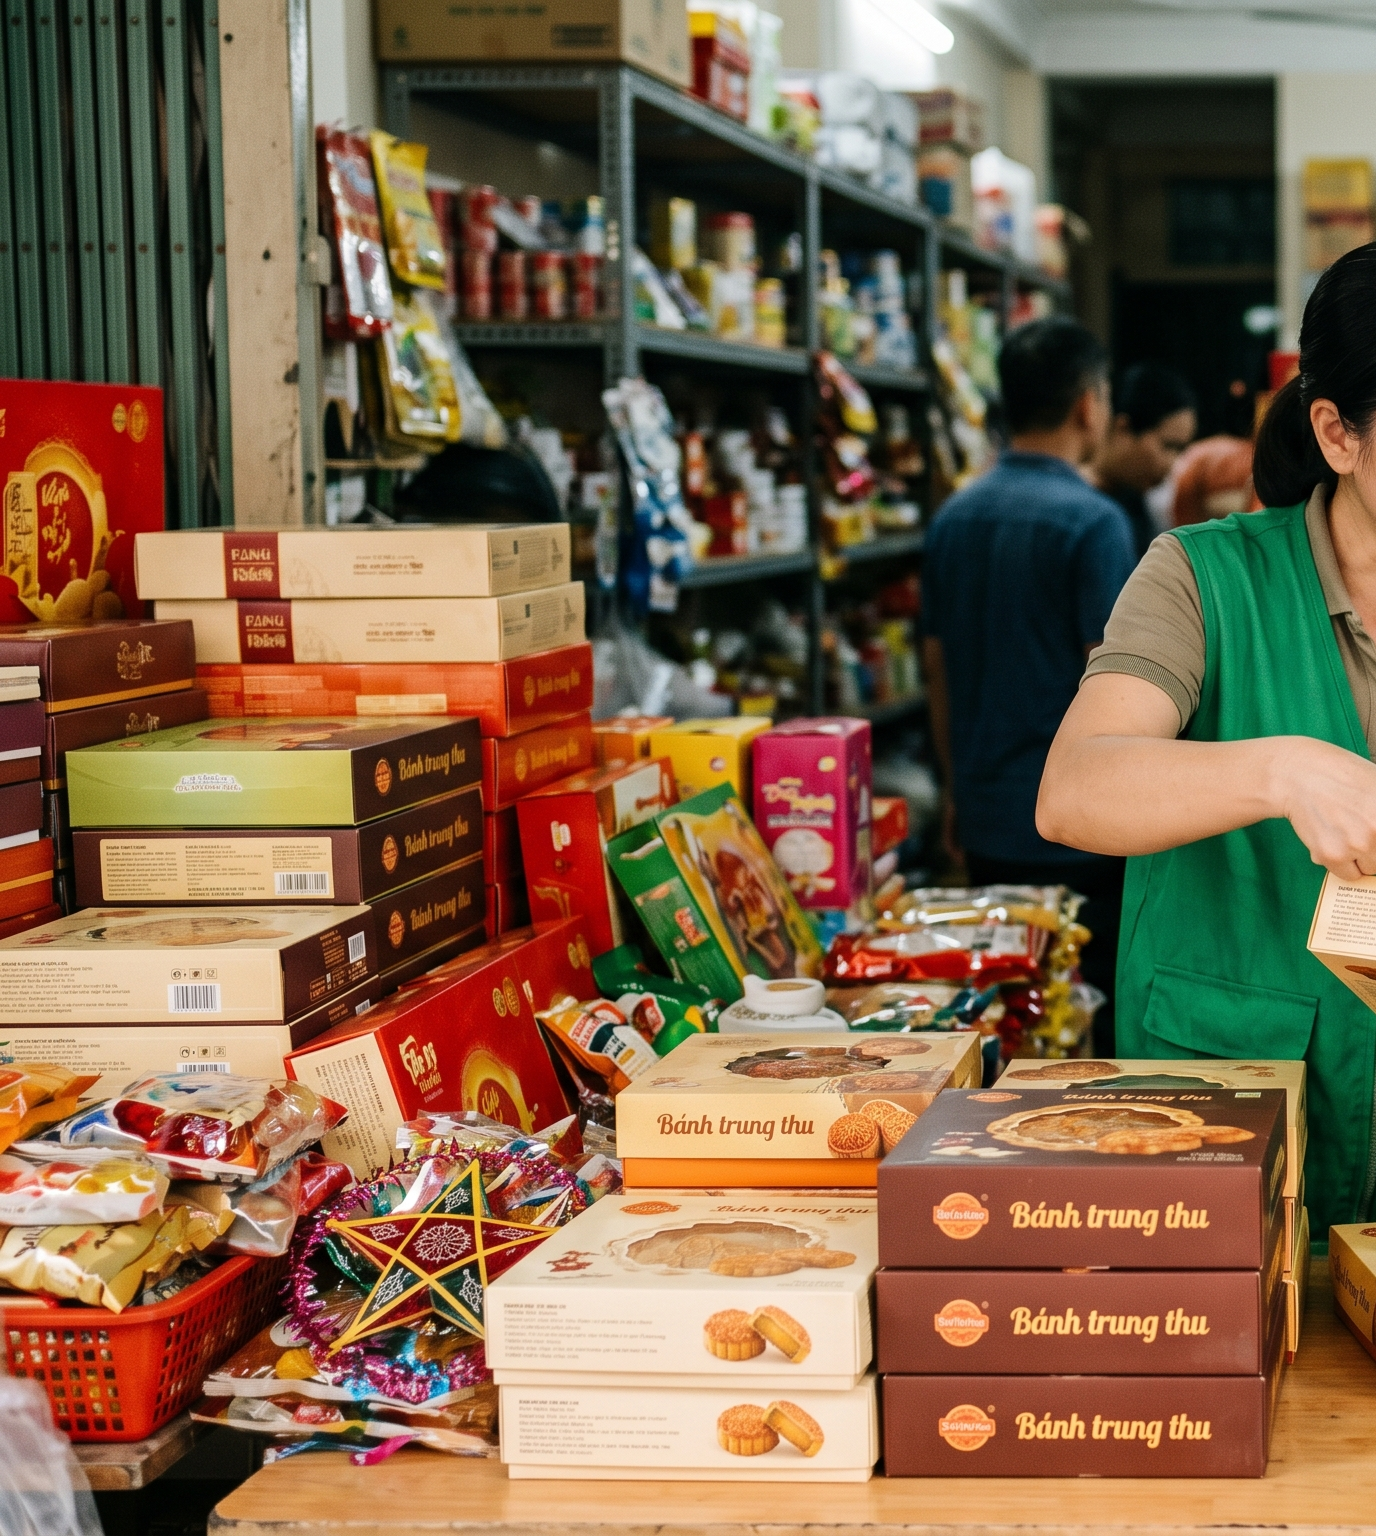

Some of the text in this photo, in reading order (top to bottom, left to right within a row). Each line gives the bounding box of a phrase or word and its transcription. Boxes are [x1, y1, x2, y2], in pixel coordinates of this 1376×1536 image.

[657, 1113, 815, 1142] Bánh trung thu
[1009, 1200, 1210, 1237] Bánh trung thu
[1009, 1306, 1083, 1335] Bánh
[1087, 1309, 1160, 1344] trung
[1164, 1307, 1211, 1336] thu
[1015, 1412, 1212, 1449] Bánh trung thu
